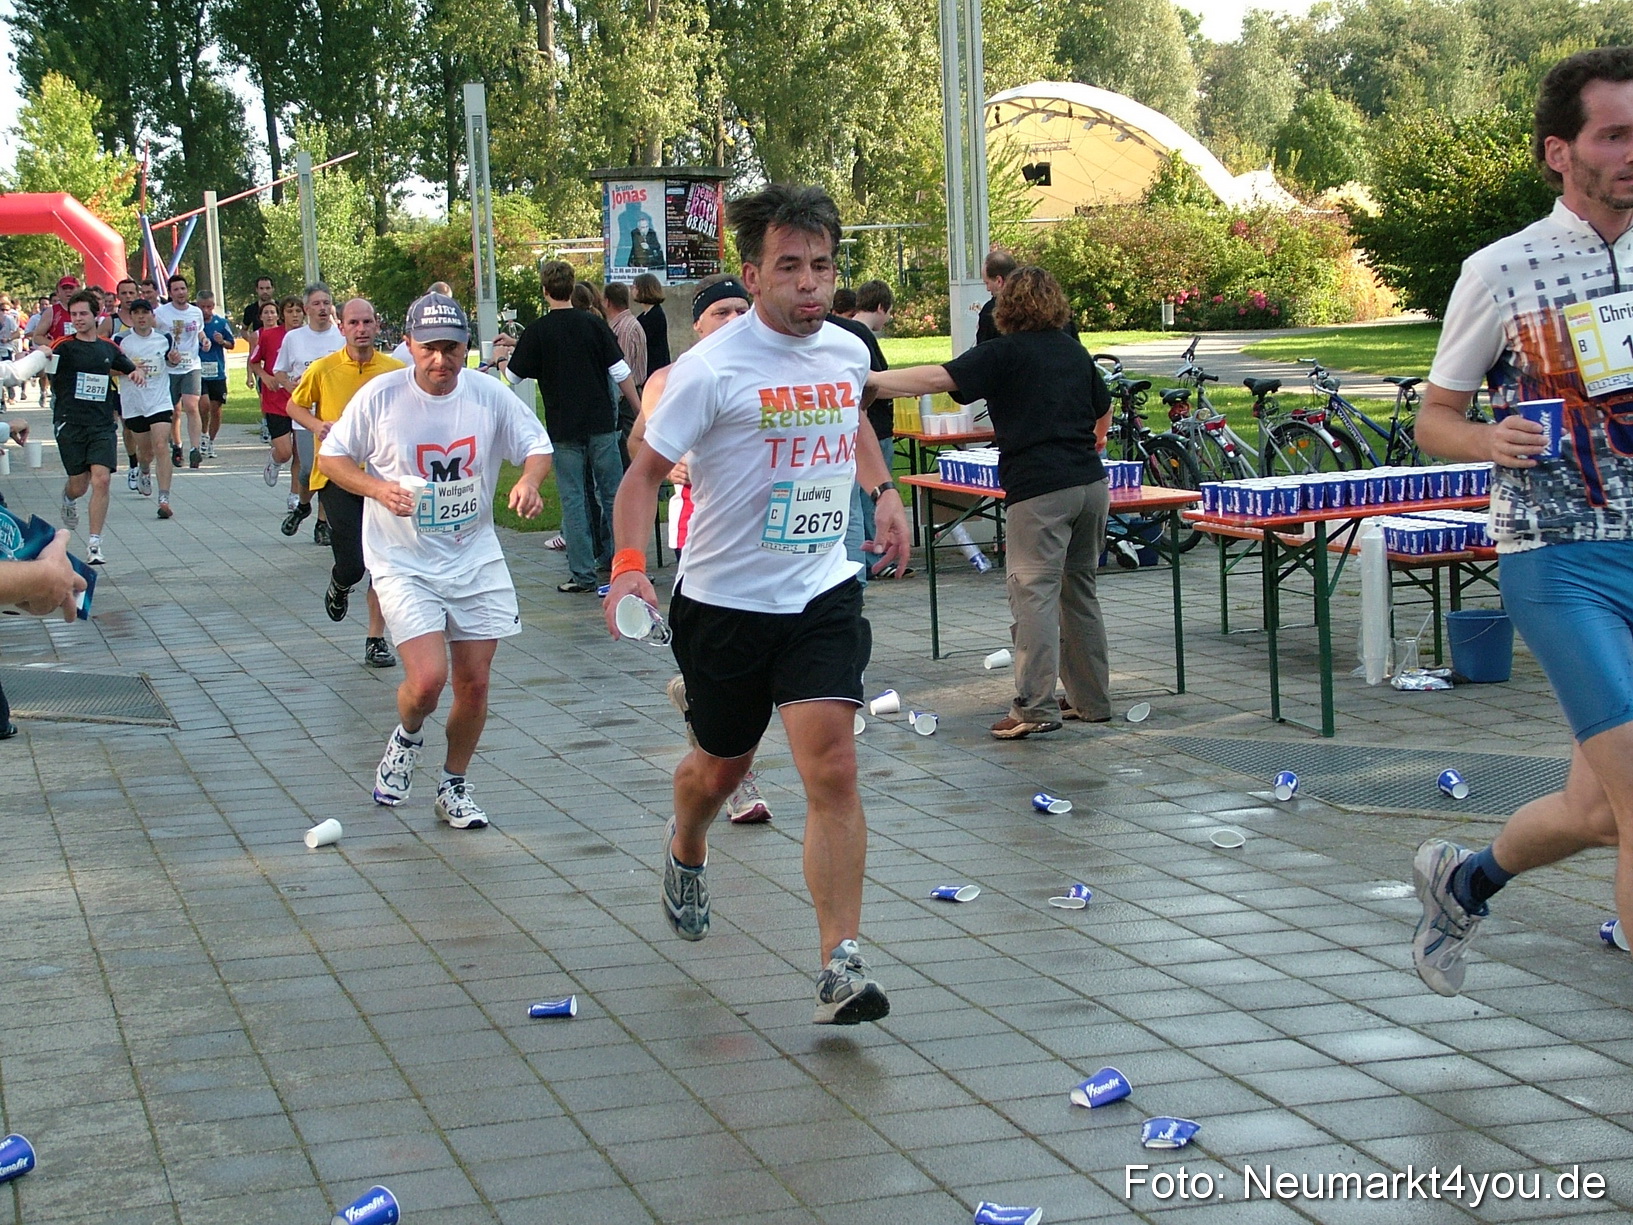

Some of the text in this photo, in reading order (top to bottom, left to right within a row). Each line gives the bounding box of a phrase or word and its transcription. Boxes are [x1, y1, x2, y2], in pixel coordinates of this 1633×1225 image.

[611, 188, 647, 210] Jonas
[615, 184, 634, 192] Bruno
[690, 196, 718, 225] ROCK
[1578, 339, 1587, 353] B
[758, 381, 855, 414] MERZ
[758, 403, 843, 430] Reisen
[765, 432, 857, 468] TEAM
[430, 456, 462, 482] M
[438, 484, 475, 498] Wolfgang
[796, 486, 832, 503] Ludwig
[421, 502, 427, 511] B
[439, 498, 477, 520] 2546
[771, 509, 778, 520] C
[792, 510, 844, 535] 2679
